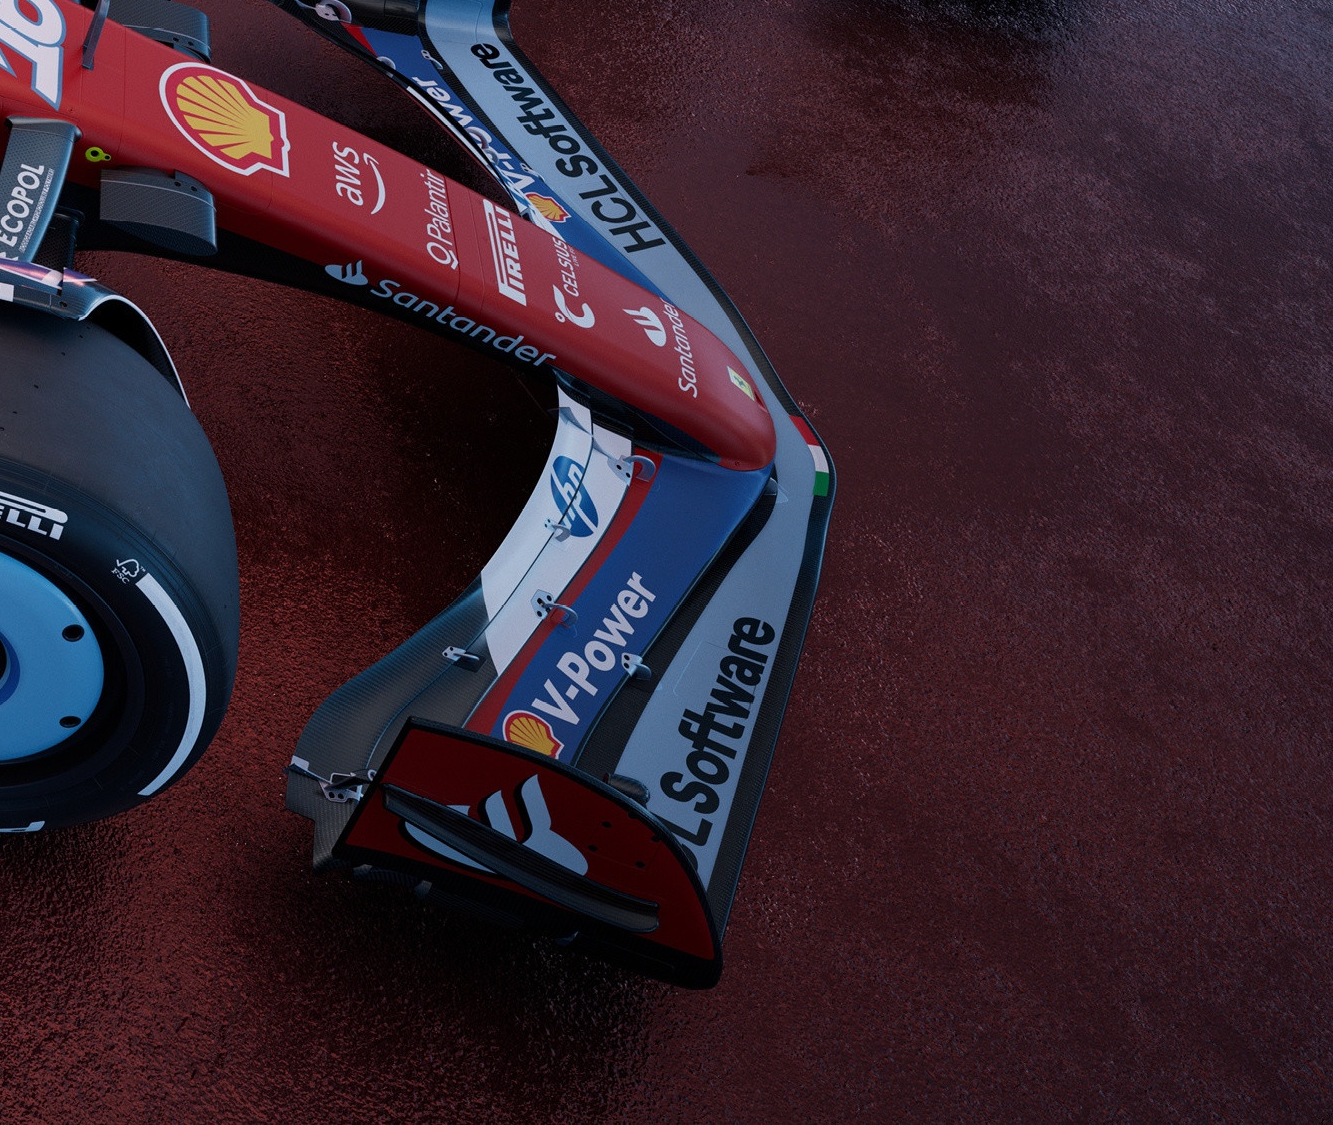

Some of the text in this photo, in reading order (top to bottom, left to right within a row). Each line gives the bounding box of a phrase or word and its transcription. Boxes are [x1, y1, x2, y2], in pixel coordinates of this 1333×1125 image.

[332, 141, 364, 206] aws
[420, 169, 456, 246] Palantir
[483, 198, 528, 306] PIRELLI
[552, 236, 580, 298] CELSIUS
[370, 279, 557, 367] Santander
[662, 297, 698, 398] Santander
[111, 567, 130, 584] FSC
[531, 571, 657, 726] V-Power
